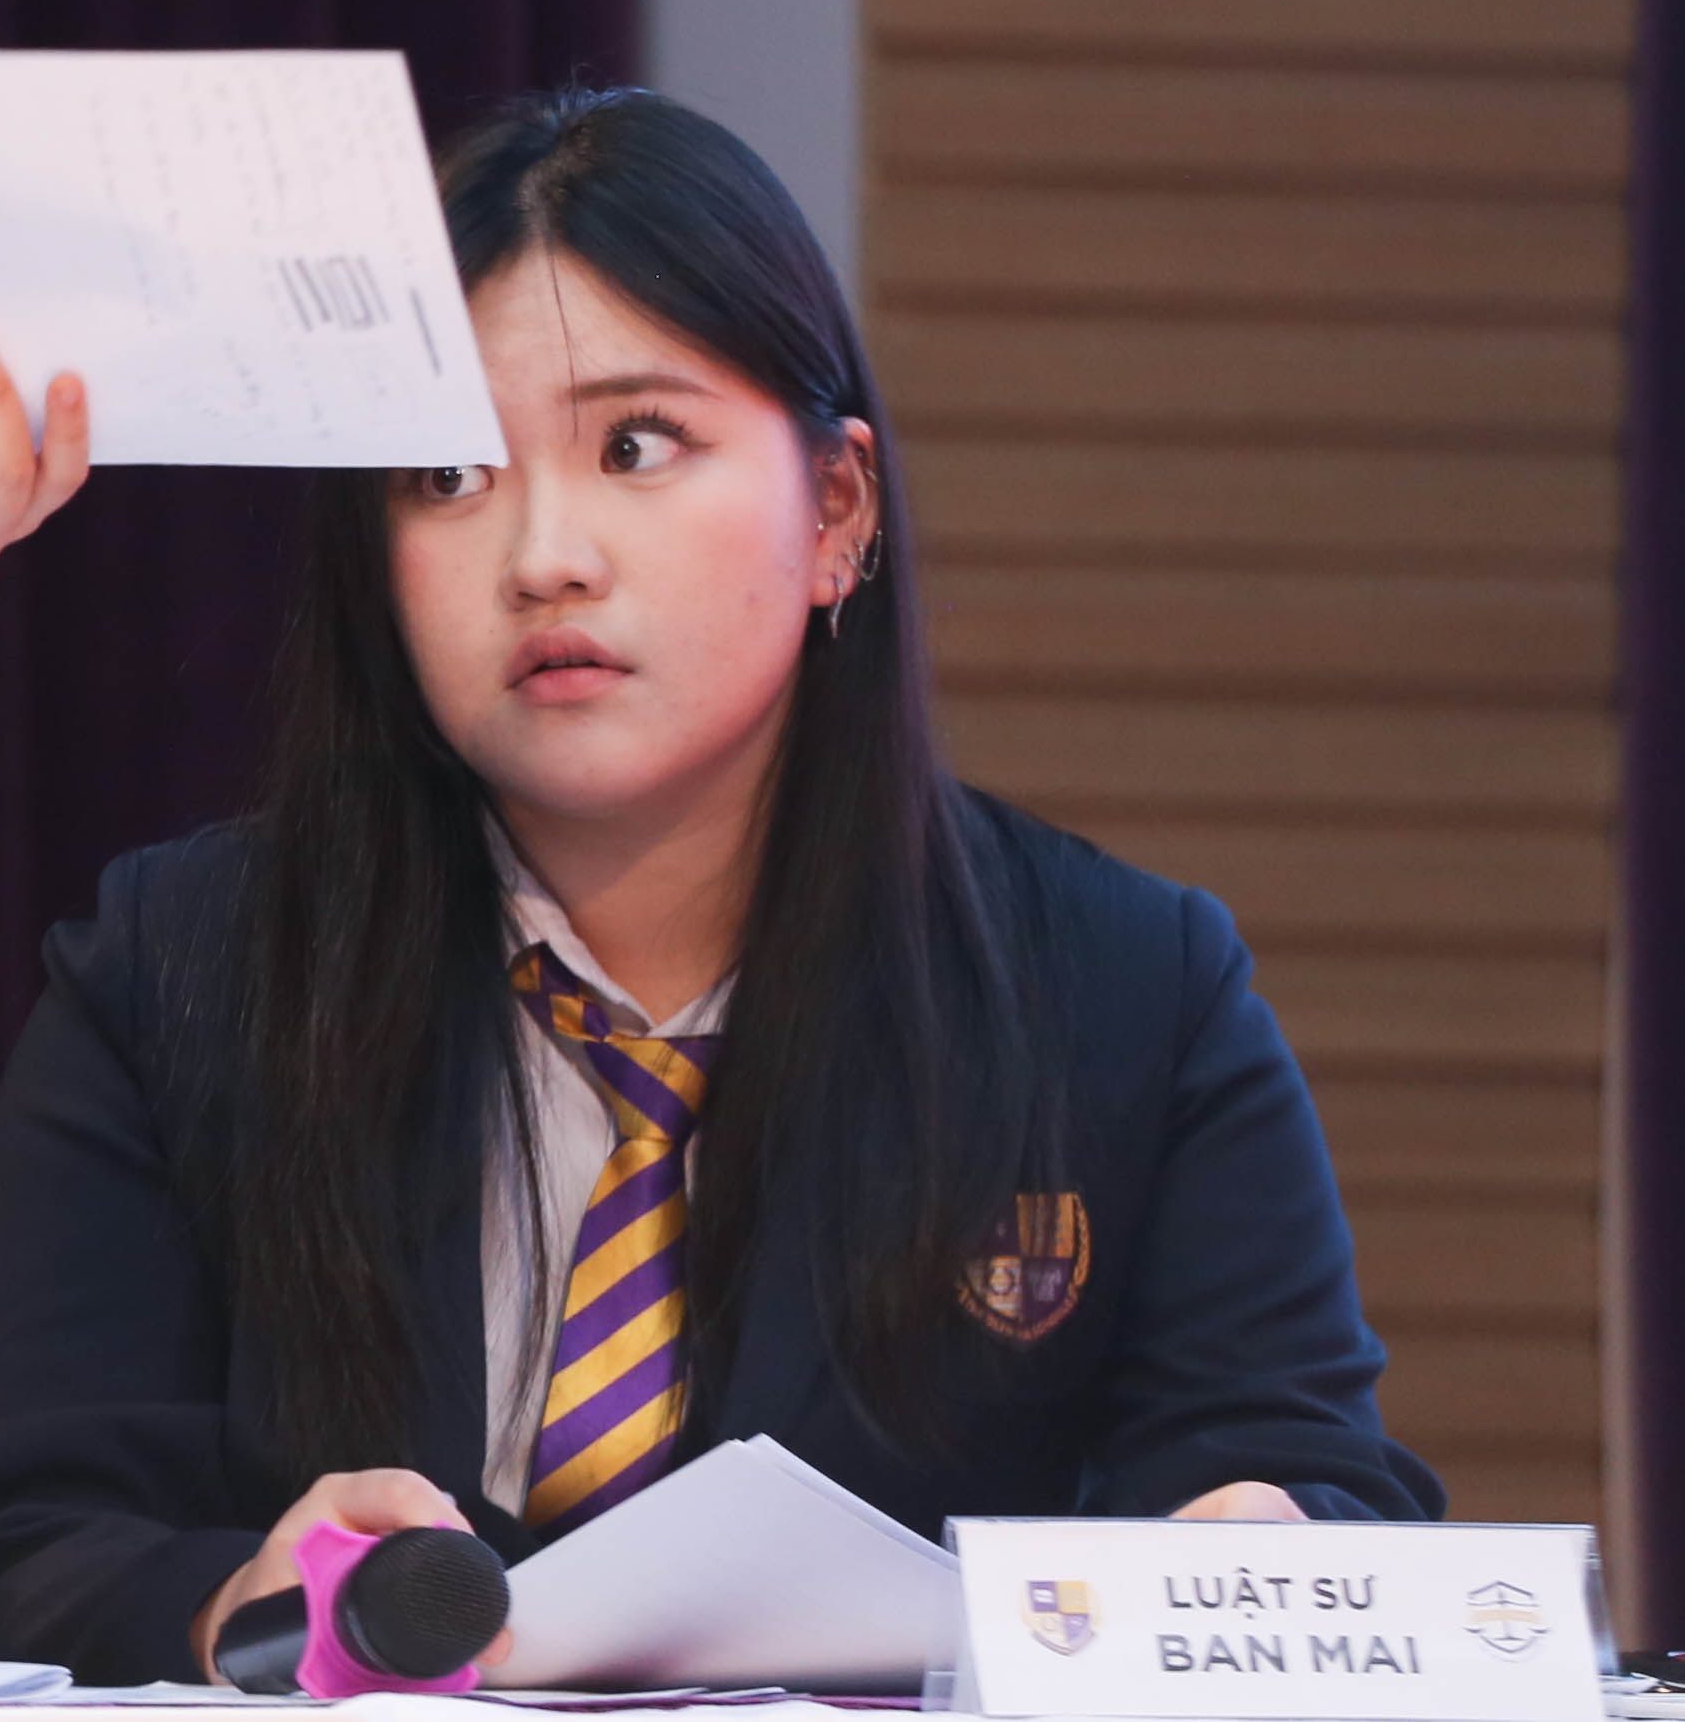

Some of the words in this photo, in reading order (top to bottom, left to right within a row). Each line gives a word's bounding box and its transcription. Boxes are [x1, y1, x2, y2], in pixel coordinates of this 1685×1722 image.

[1165, 1566, 1292, 1620] LUẬT
[1312, 1574, 1375, 1611] SƯ
[1156, 1634, 1288, 1674] BAN
[1308, 1635, 1423, 1675] MAI
